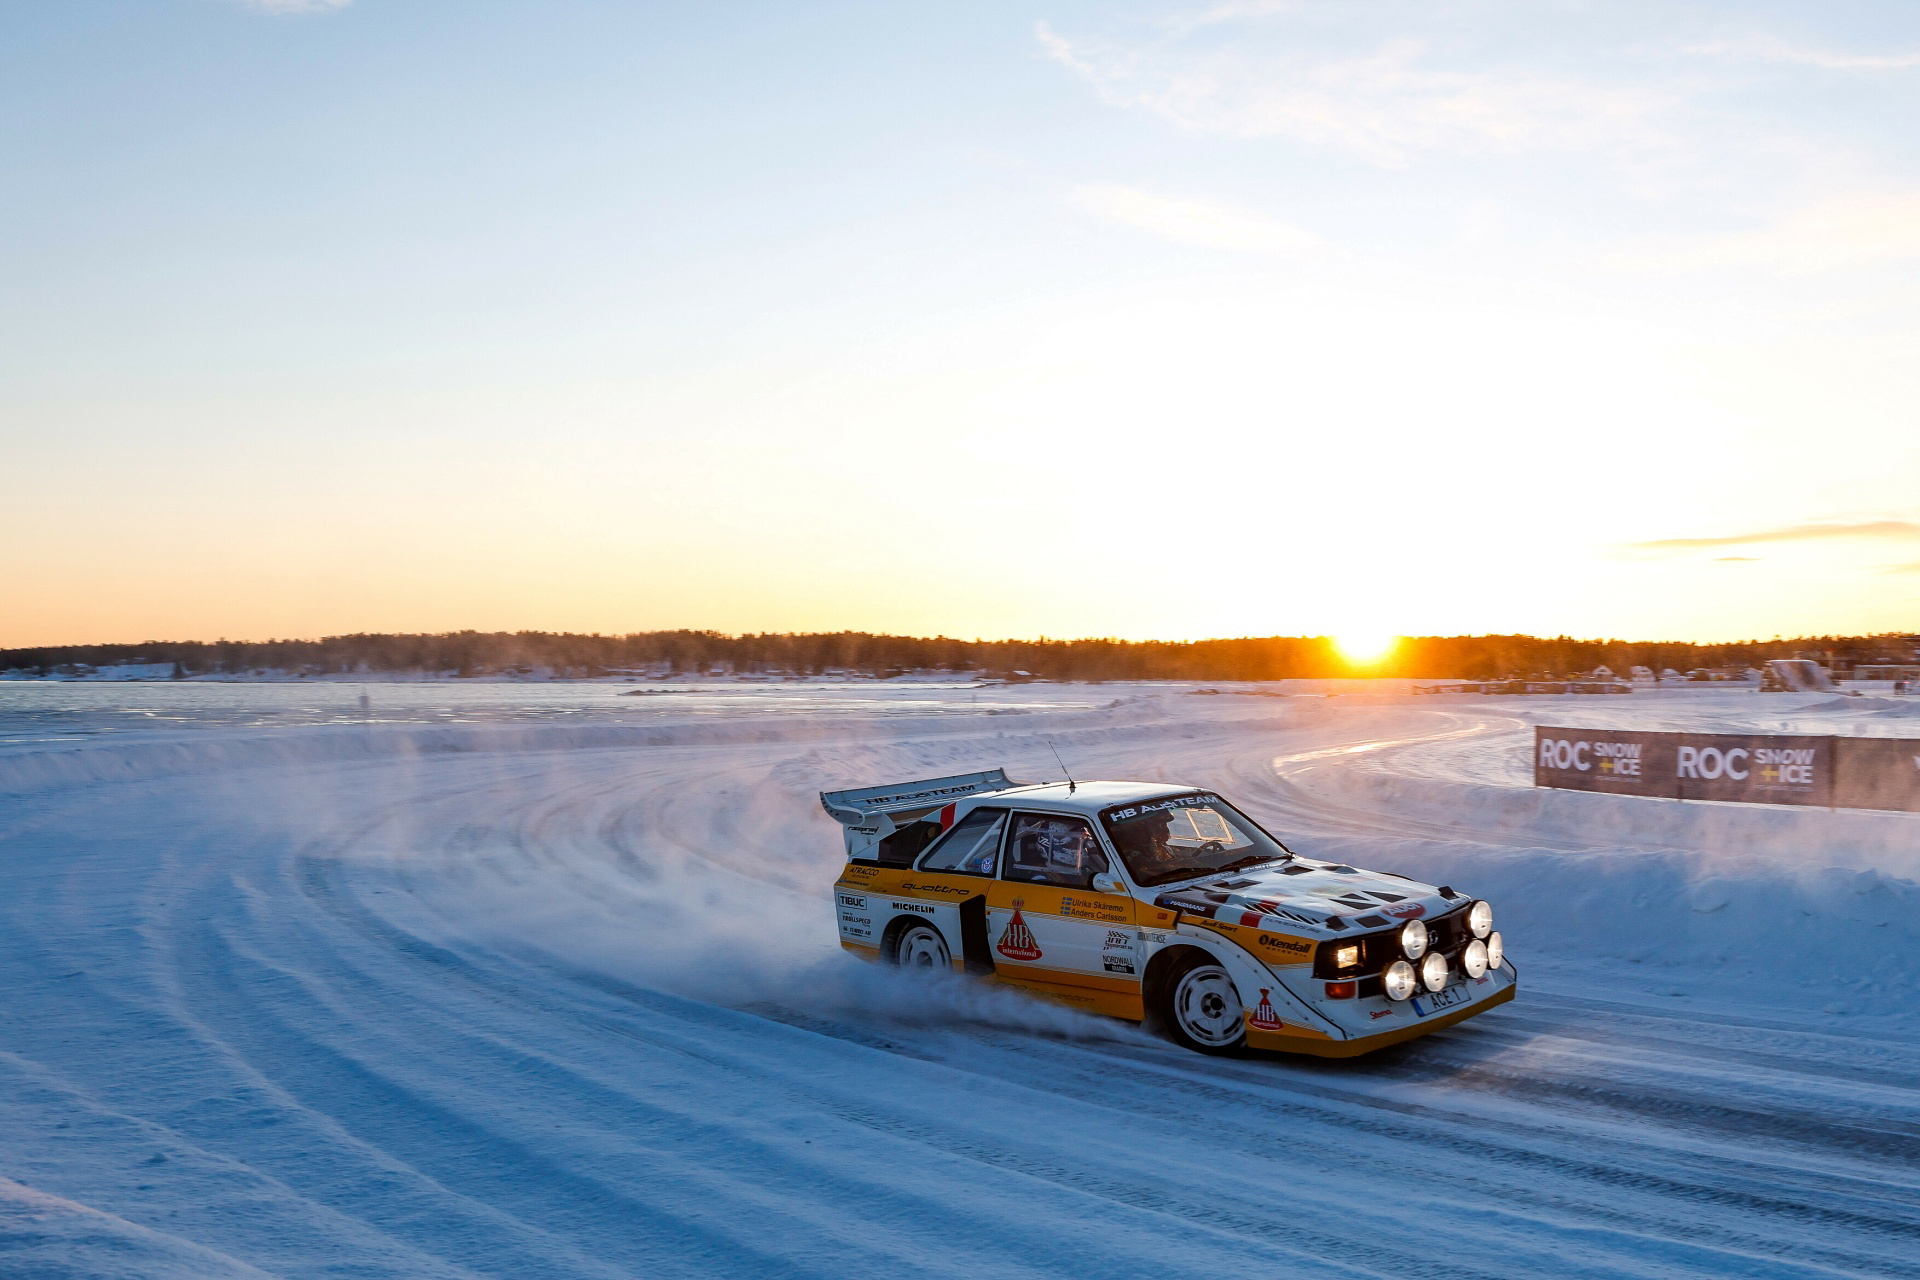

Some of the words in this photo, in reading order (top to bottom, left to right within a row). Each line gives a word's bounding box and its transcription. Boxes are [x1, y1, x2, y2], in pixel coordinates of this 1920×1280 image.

[1540, 738, 1591, 771] ROC
[1593, 741, 1642, 758] SNOW
[1754, 748, 1816, 765] SNOW
[1677, 746, 1749, 780] ROC
[866, 797, 889, 805] HB
[931, 785, 975, 796] TEAM
[1110, 808, 1138, 822] HB
[1174, 795, 1220, 806] TEAM
[849, 866, 879, 876] ATRACCO
[902, 883, 970, 896] quattro
[840, 895, 865, 907] TIBUC
[892, 902, 935, 914] MICHELIN
[1072, 898, 1092, 908] Ulrika
[1070, 908, 1095, 918] Anders
[1096, 911, 1127, 922] Carlsson
[1006, 923, 1030, 949] HB
[1268, 937, 1312, 954] Kendall
[1103, 954, 1134, 966] NORDWALL
[1430, 992, 1451, 1009] ACE
[1453, 987, 1461, 1001] 1
[1257, 1002, 1275, 1022] HB
